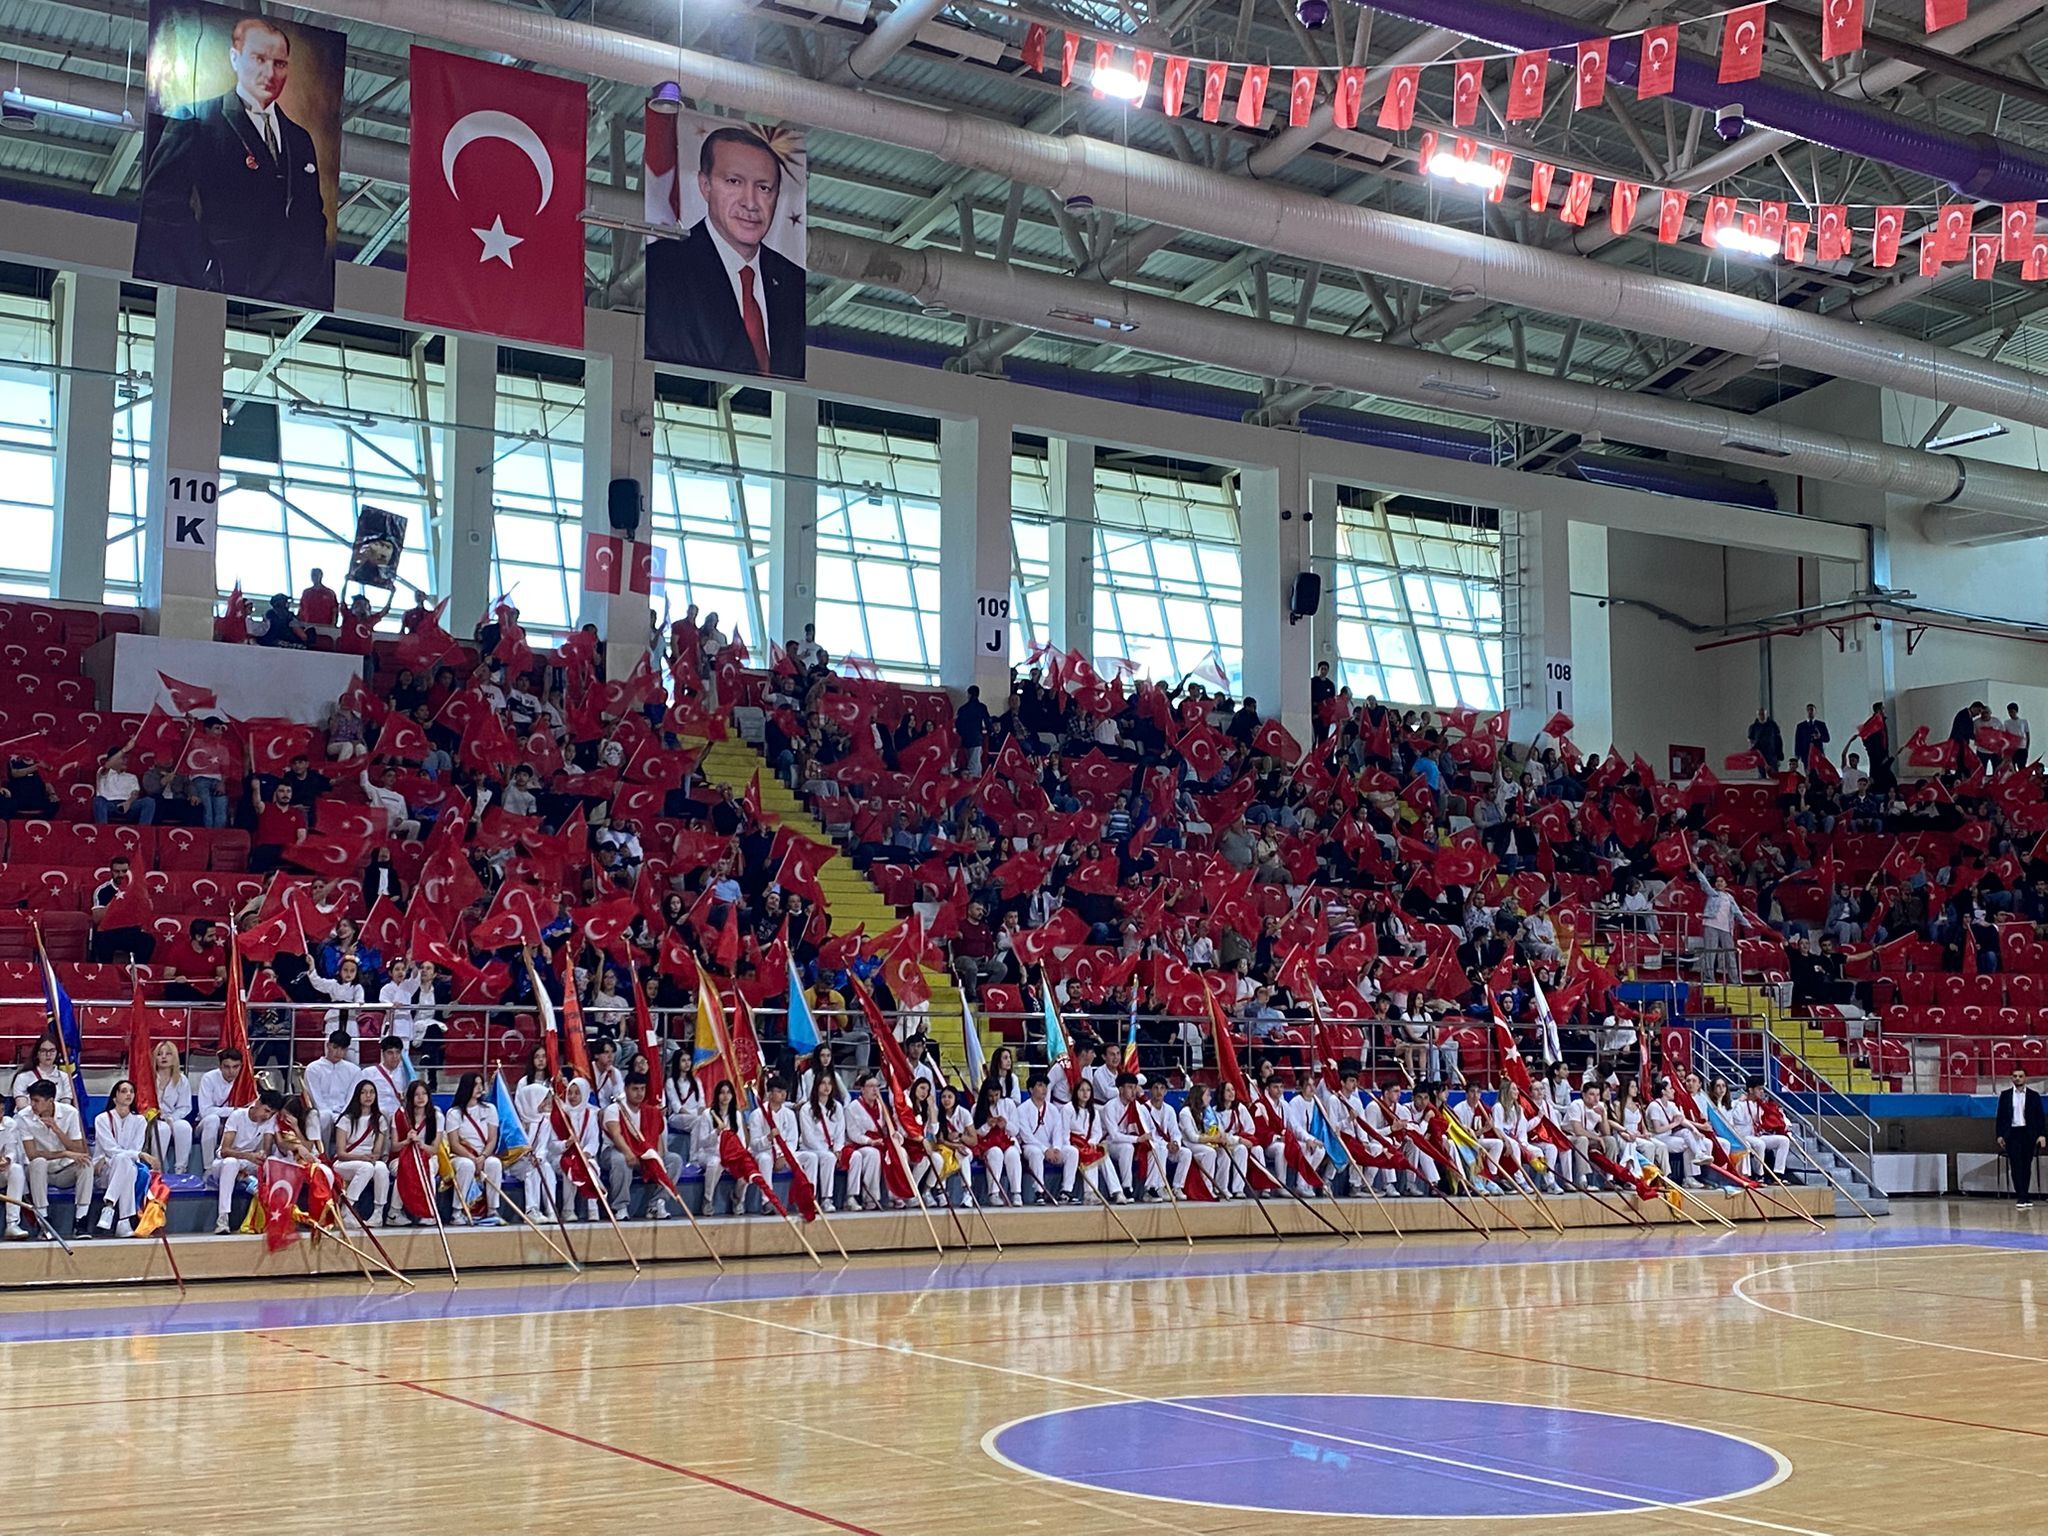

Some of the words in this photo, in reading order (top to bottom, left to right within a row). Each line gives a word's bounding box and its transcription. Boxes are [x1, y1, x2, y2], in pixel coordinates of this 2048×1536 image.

[169, 477, 217, 504] 110
[176, 515, 205, 545] K
[977, 596, 1010, 618] 109
[986, 629, 1001, 651] J
[1546, 663, 1572, 681] 108
[1557, 691, 1562, 710] I
